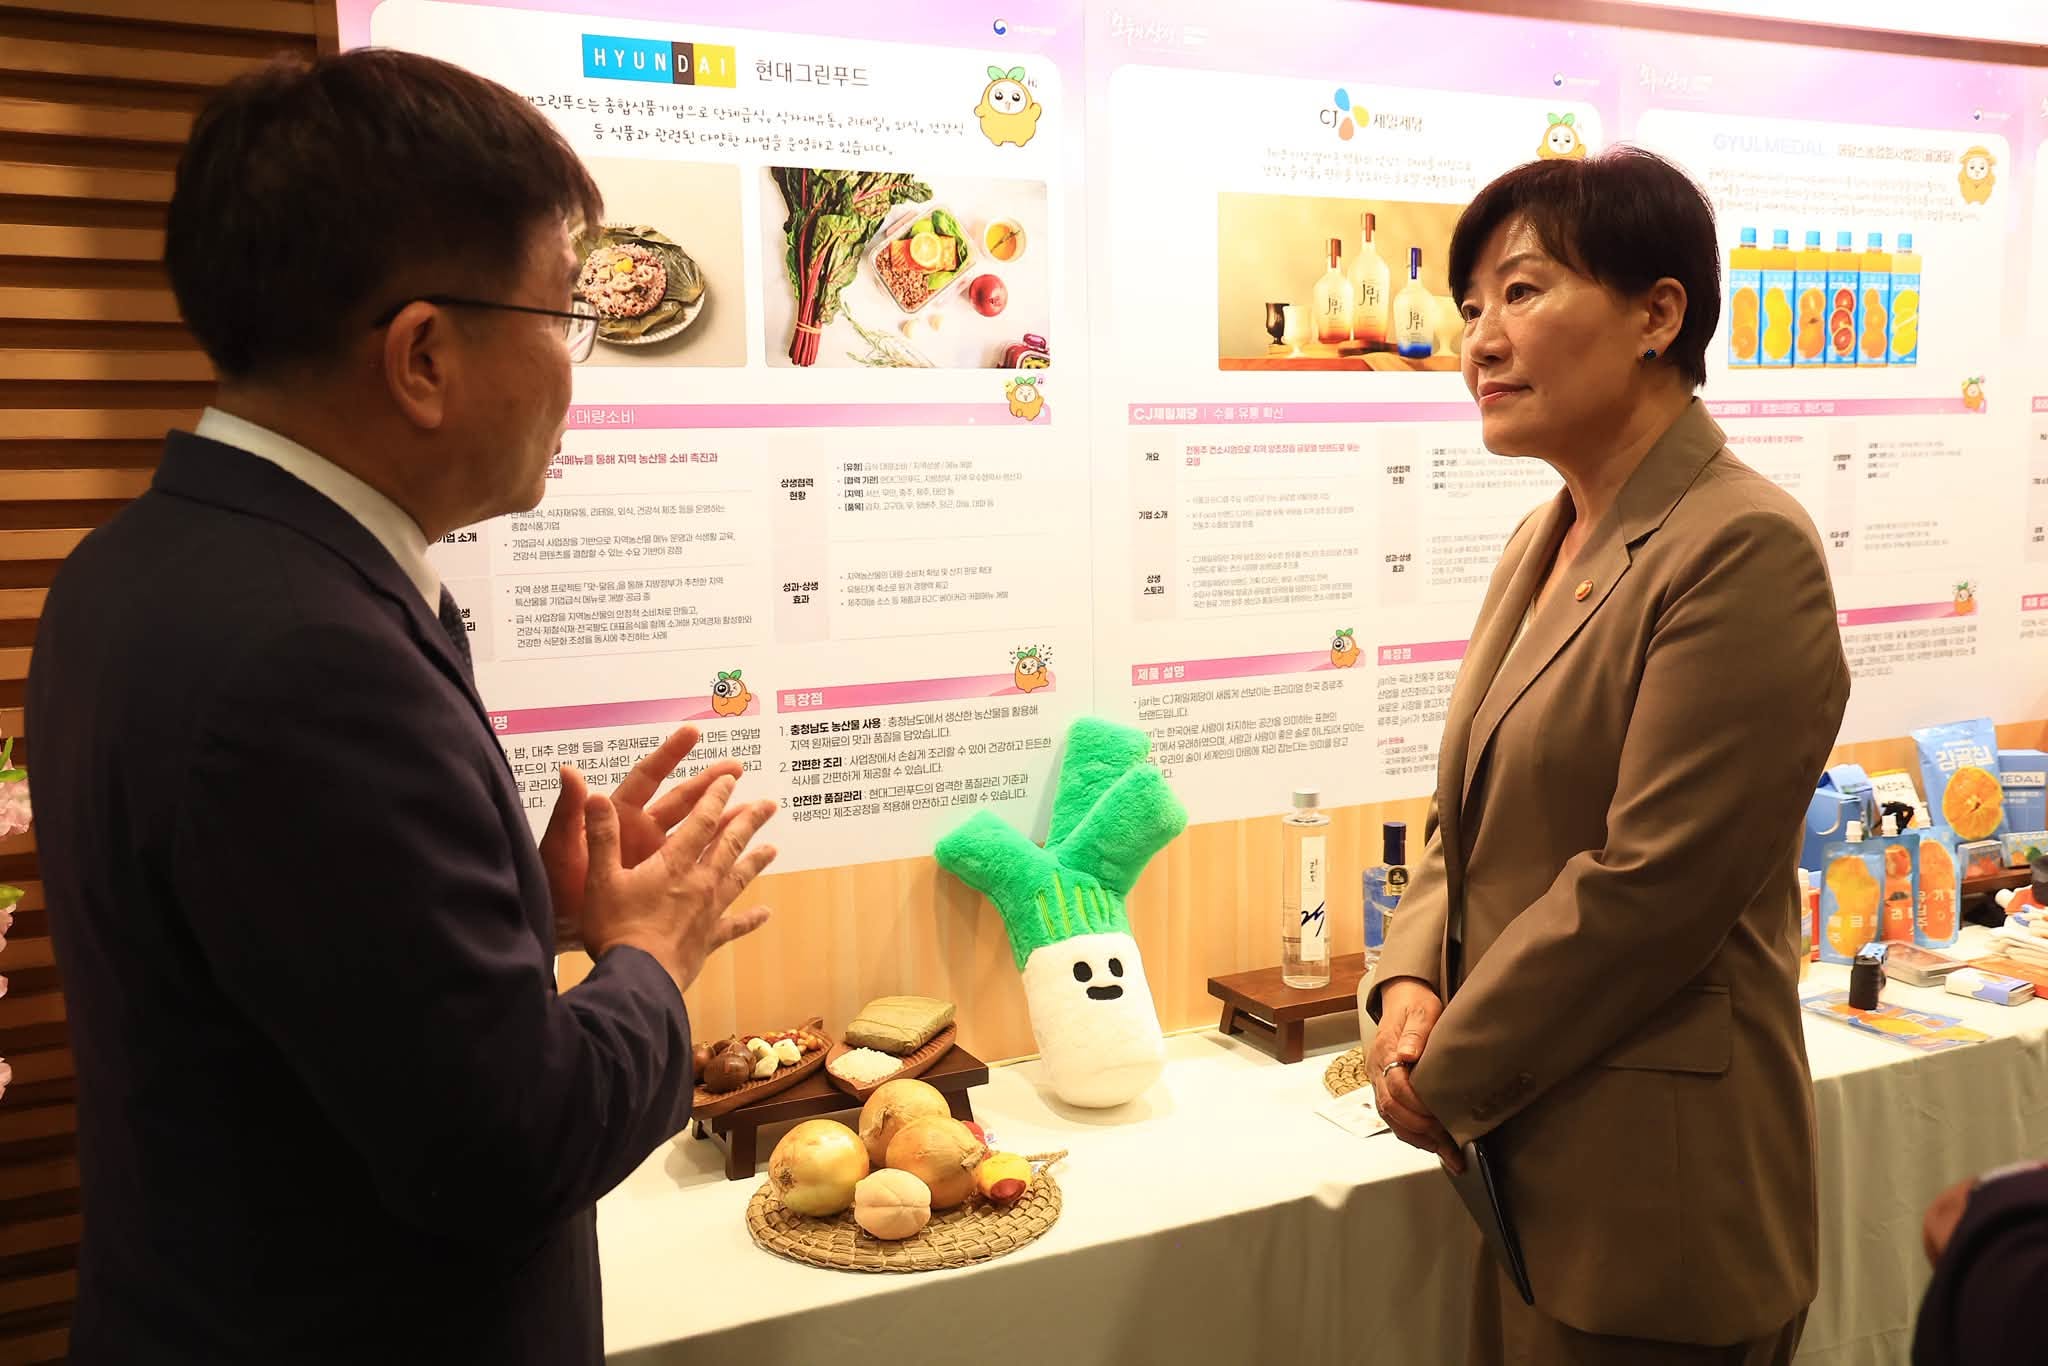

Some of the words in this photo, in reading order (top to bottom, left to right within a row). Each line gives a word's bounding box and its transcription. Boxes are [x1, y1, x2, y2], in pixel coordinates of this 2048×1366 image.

[594, 47, 726, 75] HYUNDAI
[756, 59, 870, 86] 현대그린푸드
[1319, 109, 1338, 128] CJ
[593, 123, 604, 140] 등
[610, 124, 649, 142] 식품과
[654, 127, 694, 144] 관련된
[700, 131, 739, 148] 다양한
[744, 132, 780, 151] 사업을
[787, 136, 833, 154] 운영하고
[838, 139, 893, 157] 있습니다.
[596, 454, 615, 464] 통해
[617, 454, 636, 464] 지역
[638, 453, 666, 464] 농산물
[669, 453, 687, 463] 소비
[690, 452, 717, 463] 촉진과
[1146, 452, 1160, 462] 개요
[780, 478, 814, 489] 상생협력
[789, 490, 806, 501] 현황
[844, 489, 863, 498] [지역]
[1138, 510, 1152, 520] 기업
[1153, 510, 1167, 518] 소개
[457, 532, 476, 543] 소개
[512, 550, 537, 561] 건강식
[597, 548, 606, 557] 수
[607, 547, 624, 557] 있는
[624, 547, 640, 558] 수요
[1147, 574, 1161, 584] 상생
[1144, 585, 1165, 596] 스토리
[549, 593, 581, 607] 기업급식
[582, 594, 606, 605] 메뉴로
[792, 594, 810, 604] 효과
[515, 613, 532, 624] 급식
[533, 610, 566, 625] 사업장을
[517, 637, 541, 648] 건강한
[568, 633, 592, 647] 조성을
[619, 631, 649, 642] 추진하는
[650, 630, 667, 640] 사례
[1137, 668, 1159, 681] 제품
[1163, 665, 1185, 679] 설명
[1271, 681, 1303, 697] 프리미엄
[1304, 681, 1320, 692] 한국
[783, 691, 823, 707] 특장점
[779, 726, 787, 736] 1.
[790, 721, 829, 735] 충청남도
[831, 719, 859, 732] 농산물
[862, 717, 880, 729] 사용
[888, 712, 942, 727] 충청남도에서
[945, 710, 972, 722] 생산한
[974, 707, 1008, 720] 농산물을
[1012, 704, 1037, 717] 활용해
[707, 730, 728, 743] 만든
[730, 726, 760, 741] 연잎밥
[790, 738, 810, 751] 지역
[811, 733, 850, 749] 원재료의
[852, 733, 871, 745] 맛과
[873, 730, 901, 744] 품질을
[903, 726, 951, 741] 담았습니다.
[514, 746, 529, 760] 밤,
[531, 744, 555, 758] 대추
[555, 742, 578, 757] 은행
[582, 740, 603, 753] 등을
[607, 735, 661, 754] 주원재료로
[791, 757, 821, 771] 간편한
[822, 756, 842, 768] 조리
[849, 751, 895, 766] 사업장에서
[898, 748, 925, 761] 손쉽게
[928, 746, 954, 758] 조리할
[958, 745, 966, 756] 수
[968, 743, 986, 754] 있어
[988, 739, 1023, 753] 건강하고
[1025, 737, 1050, 749] 든든한
[791, 773, 820, 787] 식사를
[822, 769, 860, 784] 간편하게
[862, 766, 890, 781] 제공할
[892, 766, 902, 776] 수
[904, 761, 945, 776] 있습니다.
[781, 797, 790, 808] 3.
[792, 793, 822, 807] 안전한
[824, 789, 861, 804] 품질관리
[869, 783, 932, 799] 현대그린푸드의
[936, 780, 962, 792] 엄격한
[965, 776, 1000, 789] 품질관리
[1002, 773, 1028, 785] 기준과
[792, 805, 831, 823] 위생적인
[833, 800, 881, 818] 제조공정을
[881, 797, 910, 814] 적용해
[911, 795, 948, 811] 안전하고
[950, 792, 977, 806] 신뢰할
[979, 791, 988, 803] 수
[990, 787, 1028, 802] 있습니다.
